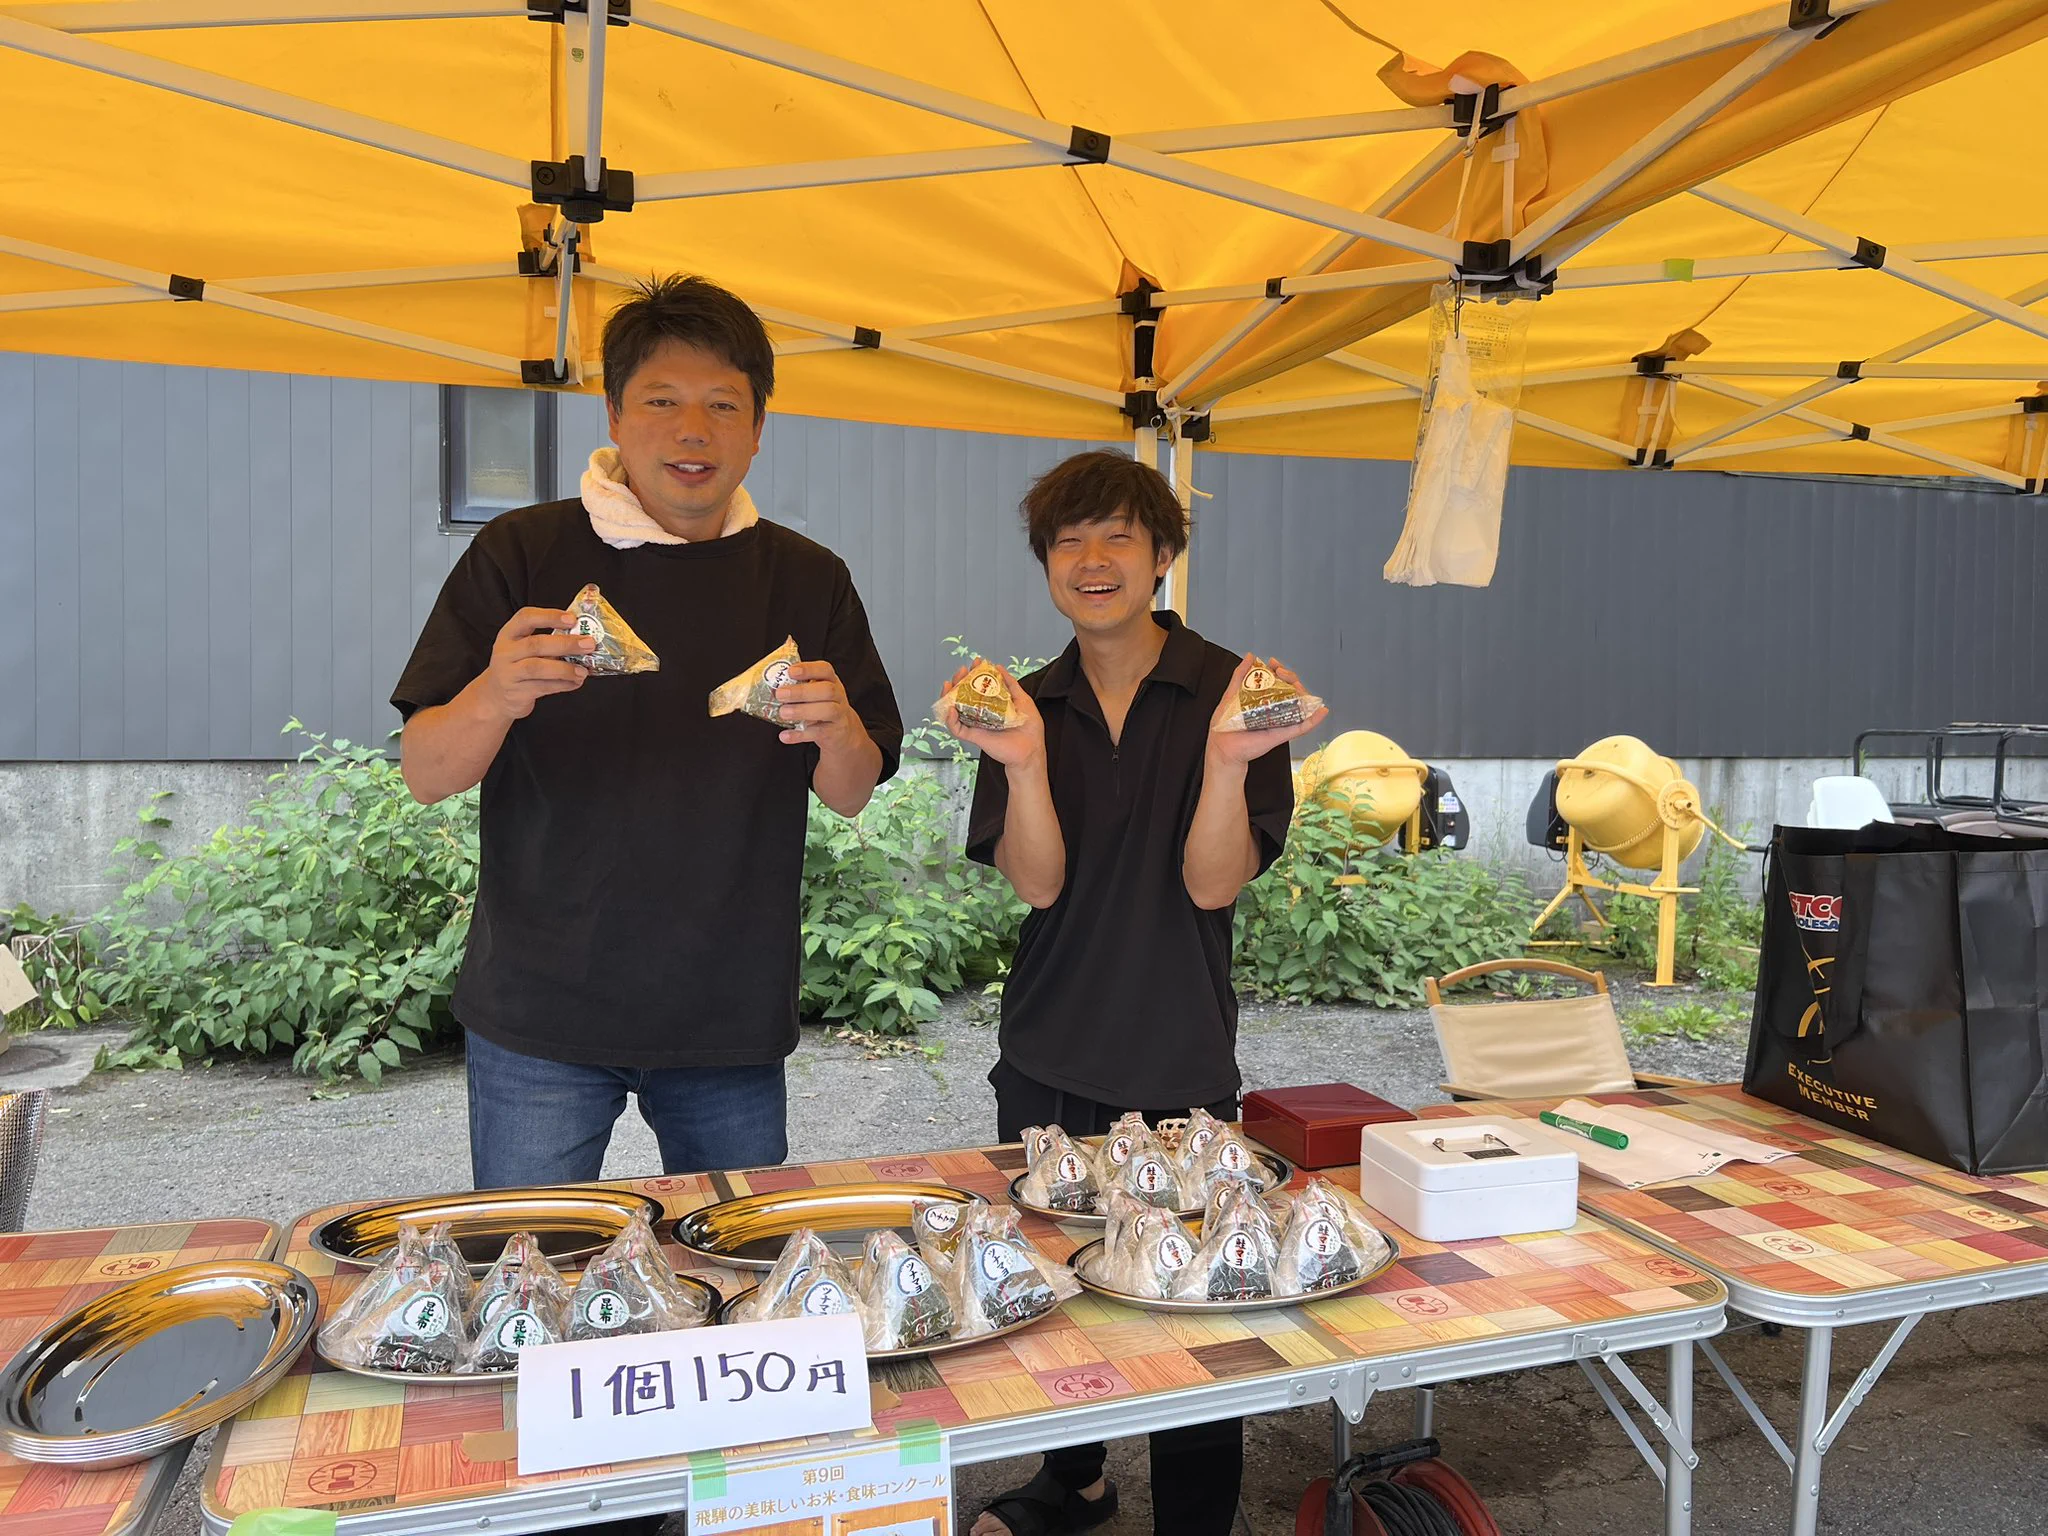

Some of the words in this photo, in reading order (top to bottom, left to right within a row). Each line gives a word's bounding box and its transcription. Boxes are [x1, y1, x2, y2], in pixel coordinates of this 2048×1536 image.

[1788, 1062, 1877, 1109] EXECUTIVE
[1798, 1083, 1870, 1121] MEMBER
[1166, 1239, 1184, 1267] 鮭マヨ
[1235, 1237, 1246, 1267] 鮭マヨ
[1317, 1224, 1330, 1253] 鮭マヨ
[987, 1248, 1010, 1277] ツナマヨ
[906, 1262, 923, 1294] ツナマヨ
[416, 1301, 436, 1330] 昆布
[600, 1297, 613, 1325] 昆布
[513, 1319, 527, 1347] 昆布
[802, 1465, 845, 1486] 第9回
[695, 1474, 947, 1527] 飛騨の美味しいお米・食味コンクール
